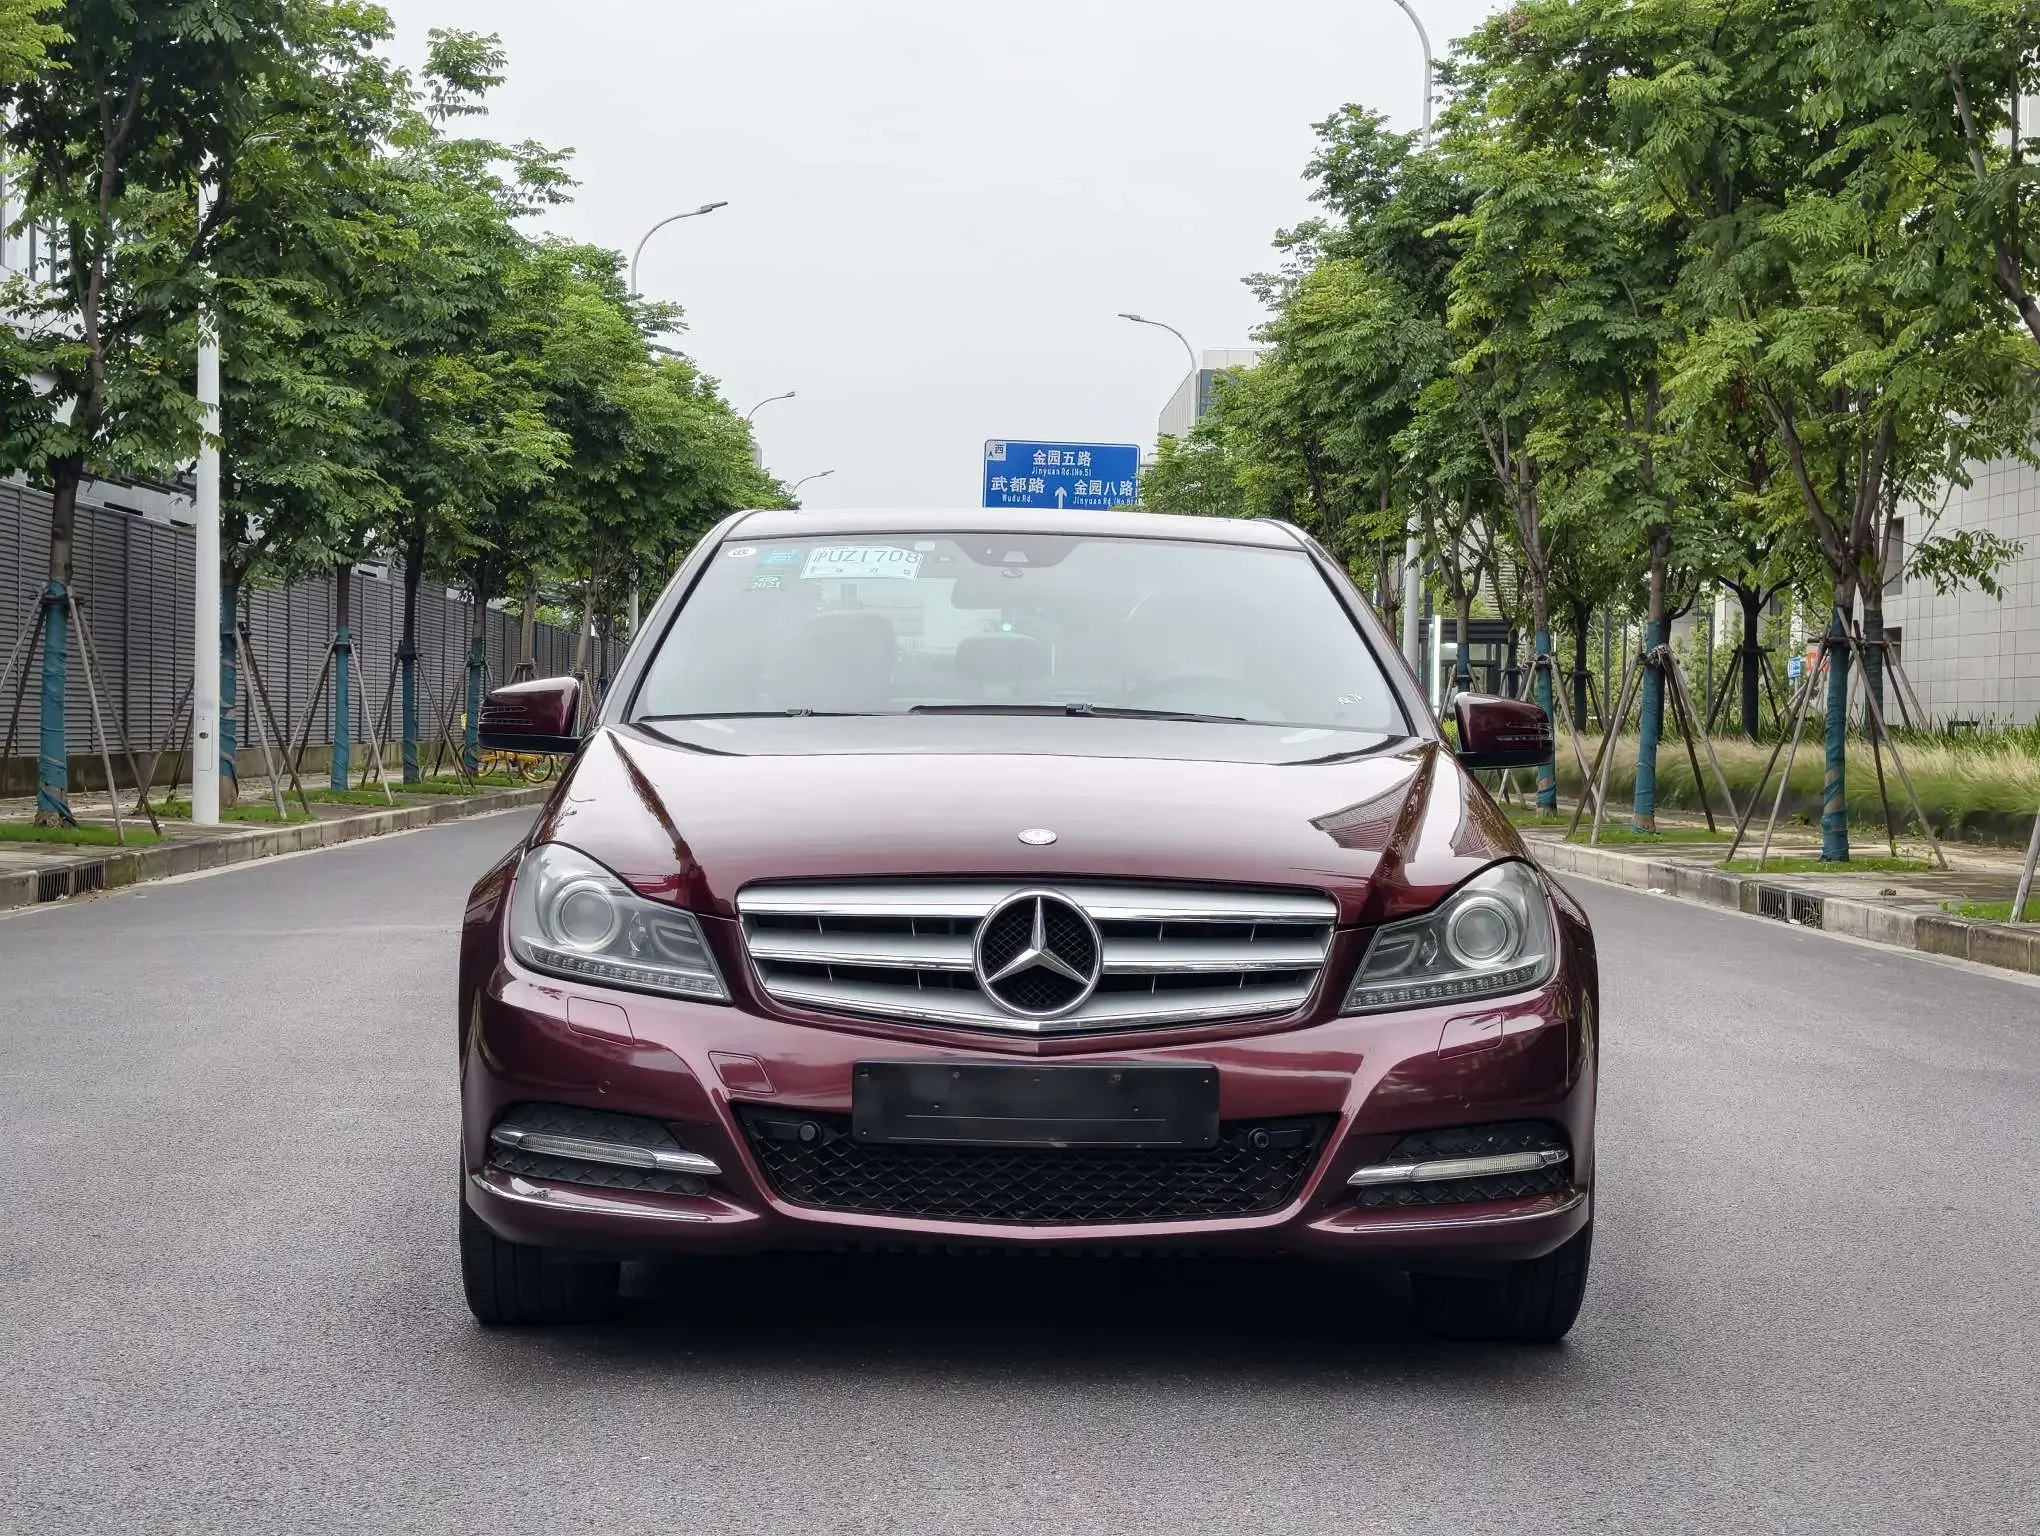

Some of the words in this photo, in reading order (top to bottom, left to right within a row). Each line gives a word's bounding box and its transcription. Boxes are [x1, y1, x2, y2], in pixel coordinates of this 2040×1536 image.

[995, 443, 1004, 454] 西
[1032, 449, 1092, 466] 金园五路
[1031, 467, 1061, 477] Jinyuan
[991, 475, 1045, 493] 武都路
[1074, 479, 1133, 496] 金园八路
[1002, 494, 1021, 503] Wudu
[1072, 496, 1102, 506] Jinyuan
